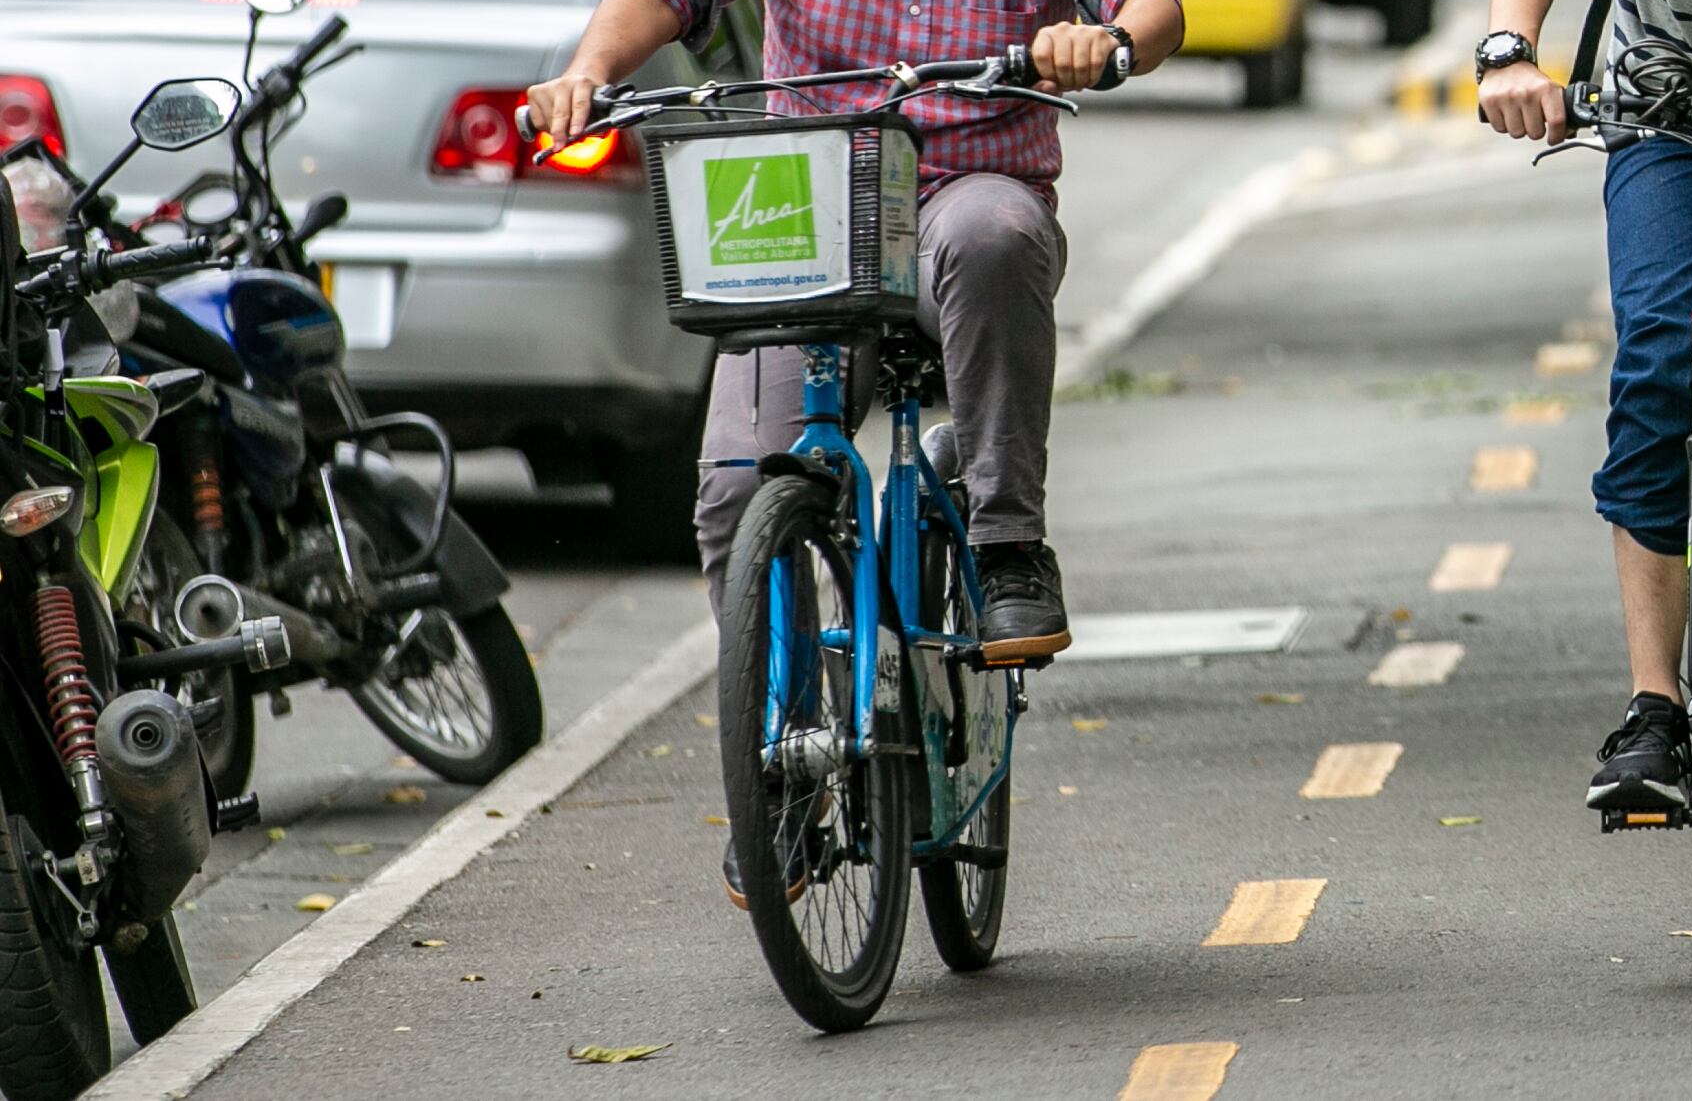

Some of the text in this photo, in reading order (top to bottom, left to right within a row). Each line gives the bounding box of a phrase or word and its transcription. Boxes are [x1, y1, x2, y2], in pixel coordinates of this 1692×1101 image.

[721, 237, 808, 250] METROPOLITANA
[721, 251, 750, 262] Valle
[752, 251, 767, 259] de
[706, 274, 827, 289] encicla.metropol.gov.co
